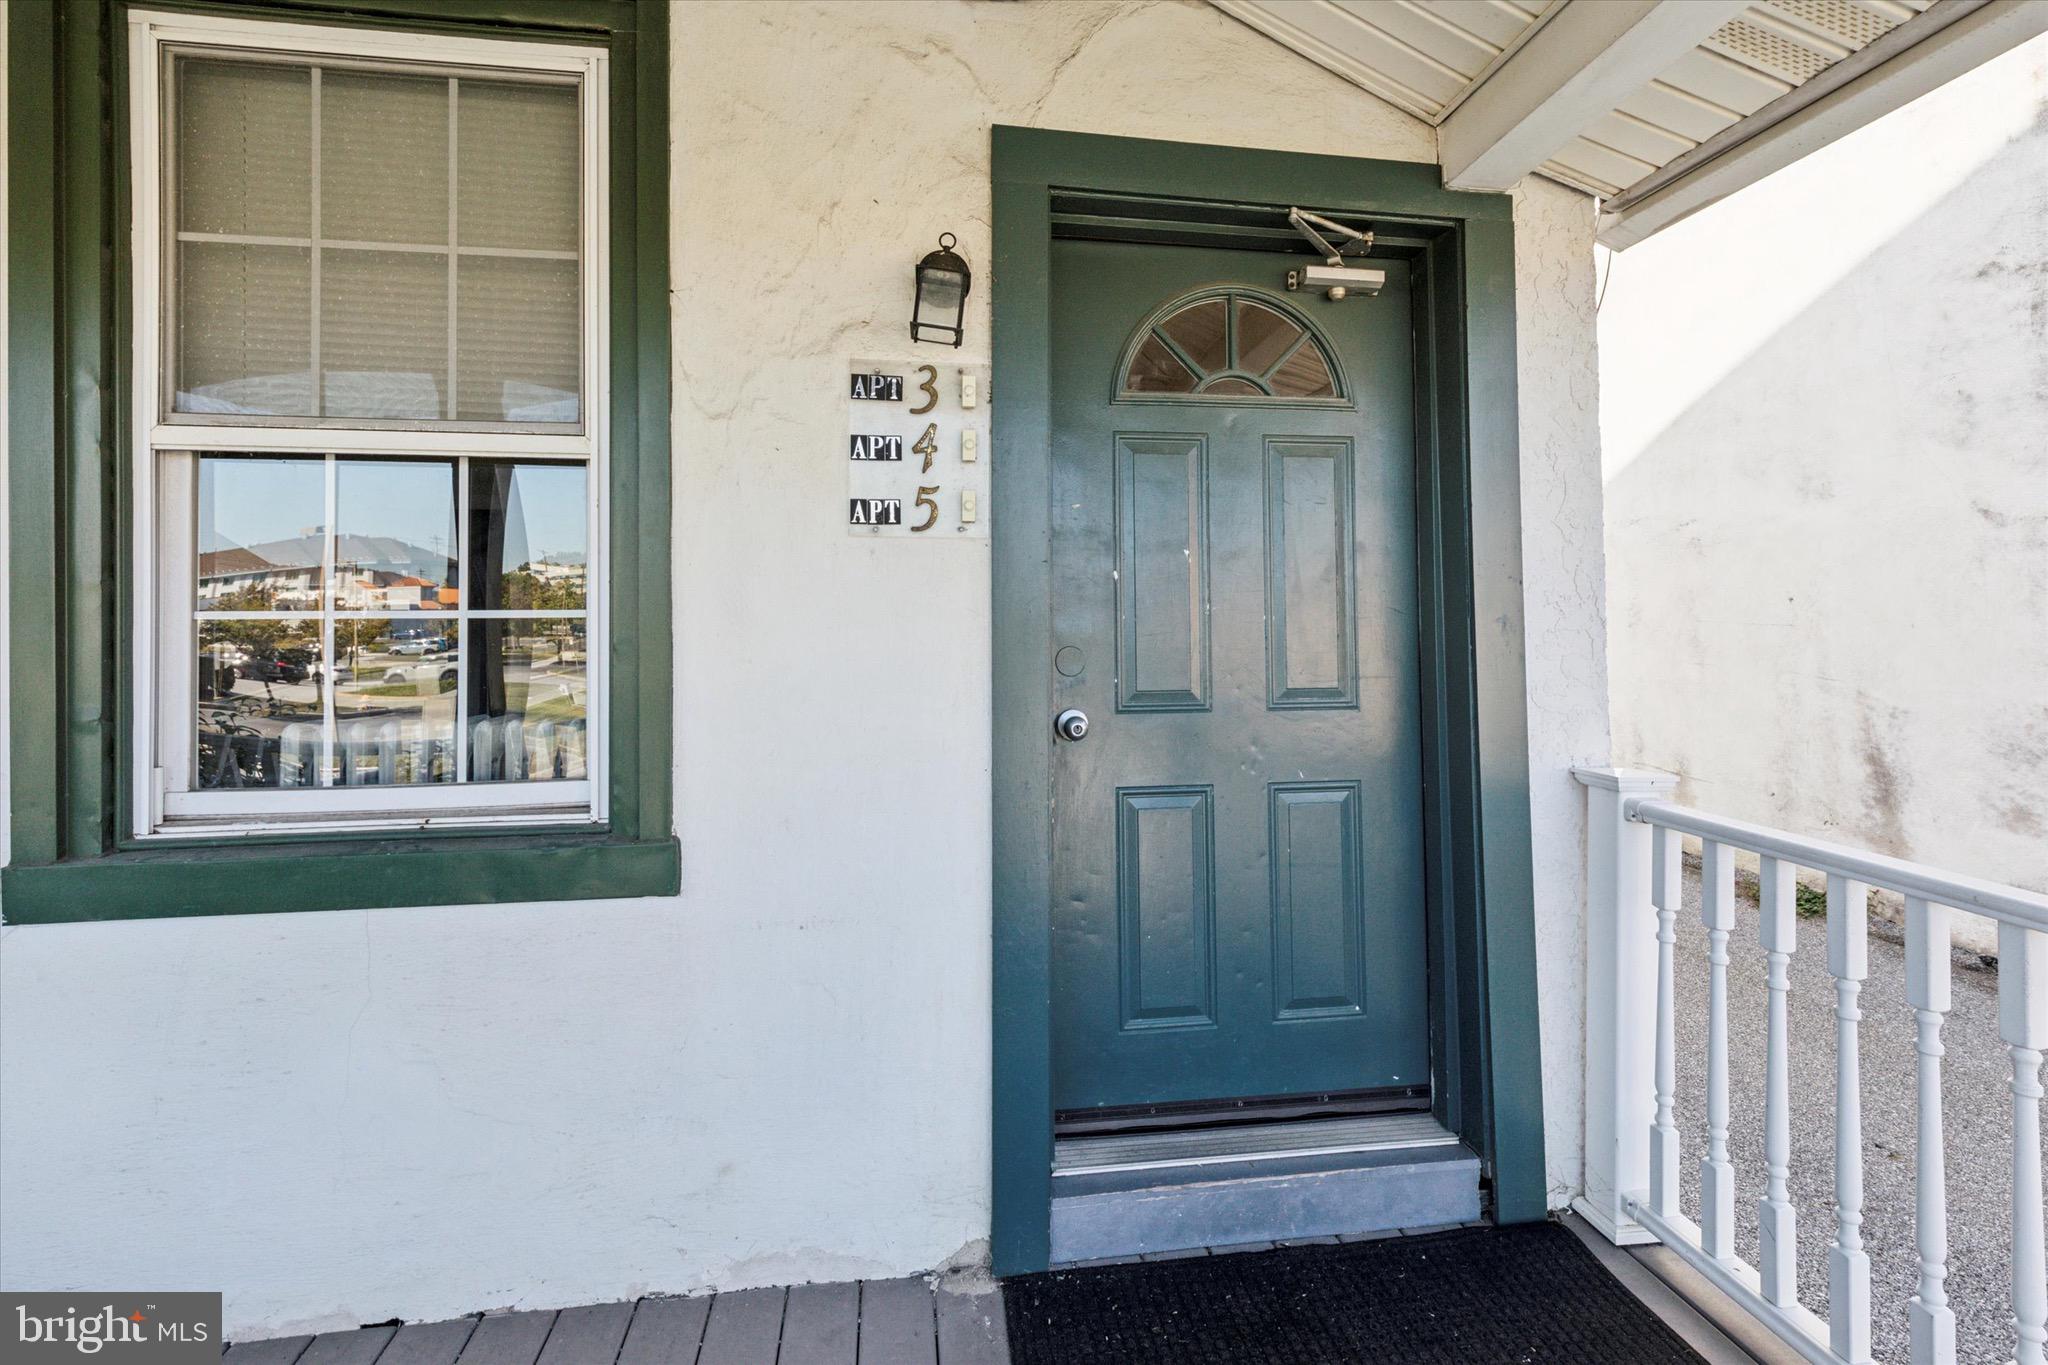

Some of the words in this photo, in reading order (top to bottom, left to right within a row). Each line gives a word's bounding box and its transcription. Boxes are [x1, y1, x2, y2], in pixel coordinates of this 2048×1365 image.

[851, 375, 903, 400] APT
[909, 364, 939, 415] 3
[851, 435, 901, 460] APT
[911, 422, 938, 474] 4
[850, 499, 900, 524] APT
[910, 485, 940, 532] 5
